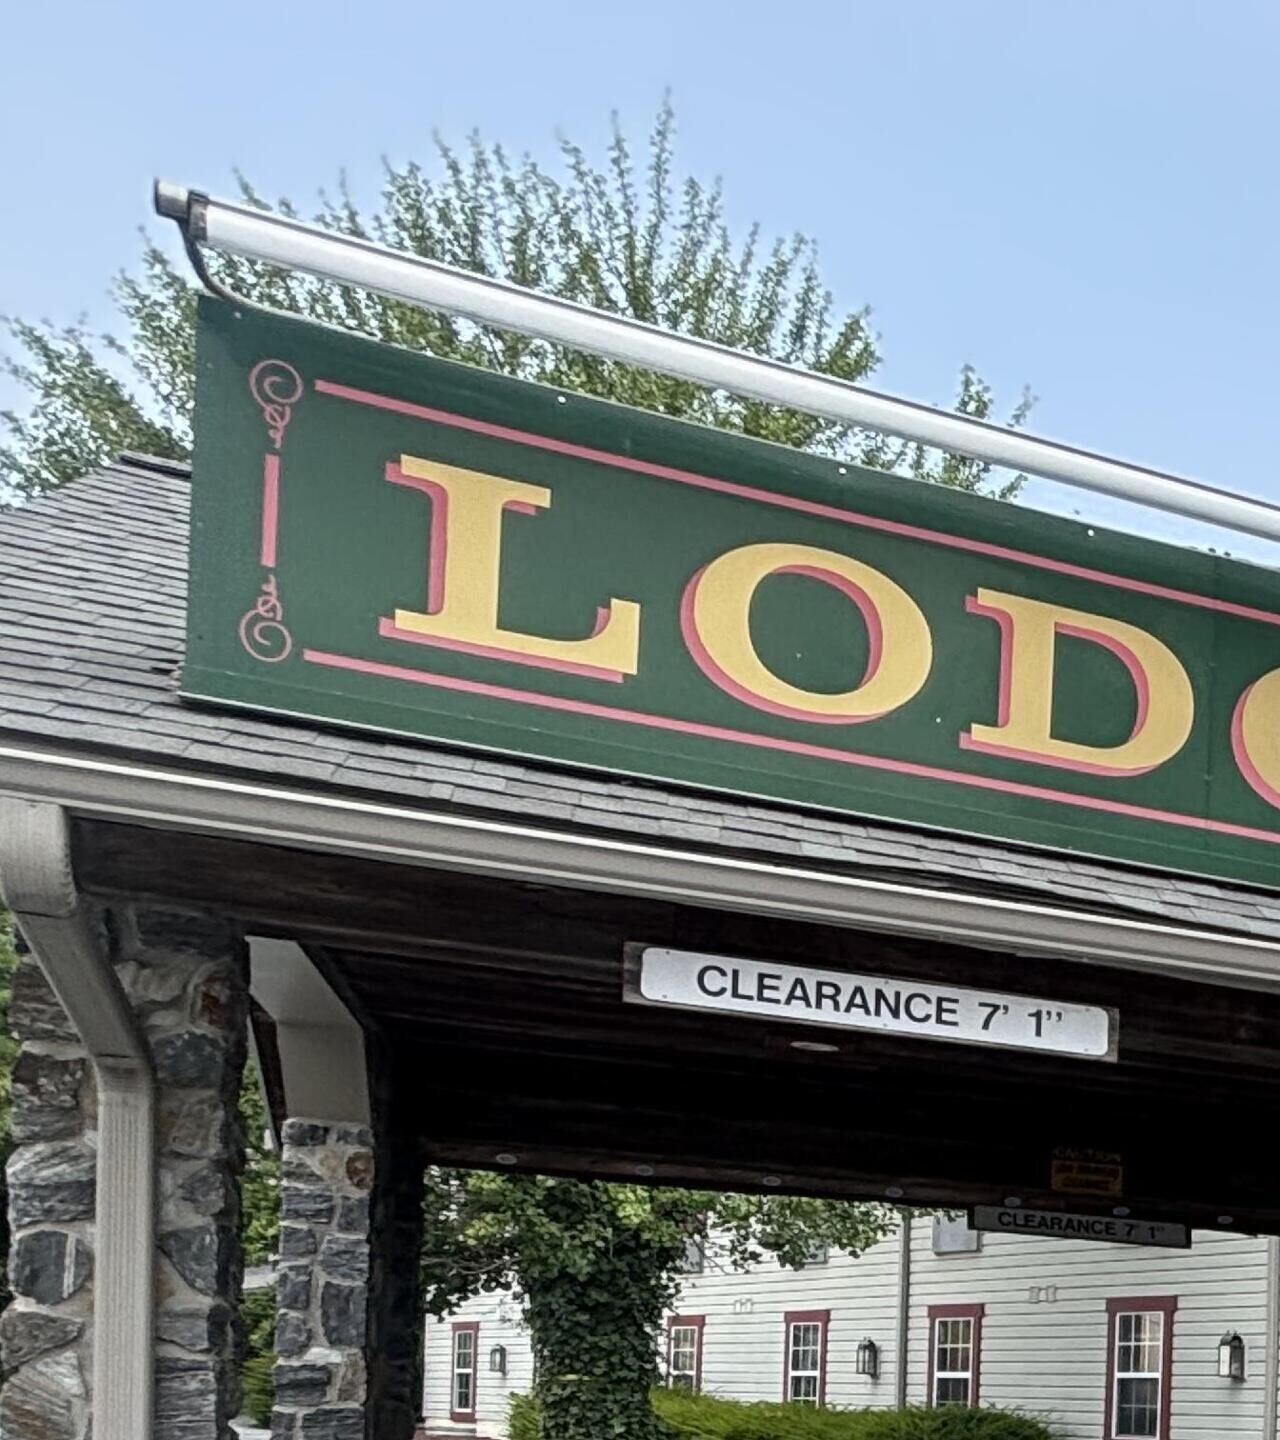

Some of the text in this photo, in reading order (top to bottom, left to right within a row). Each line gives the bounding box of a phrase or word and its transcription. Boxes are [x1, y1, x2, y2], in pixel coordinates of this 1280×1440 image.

[696, 964, 961, 1027] CLEARANCE
[977, 1002, 1010, 1031] 7'
[997, 1210, 1117, 1236] CLEARANCE
